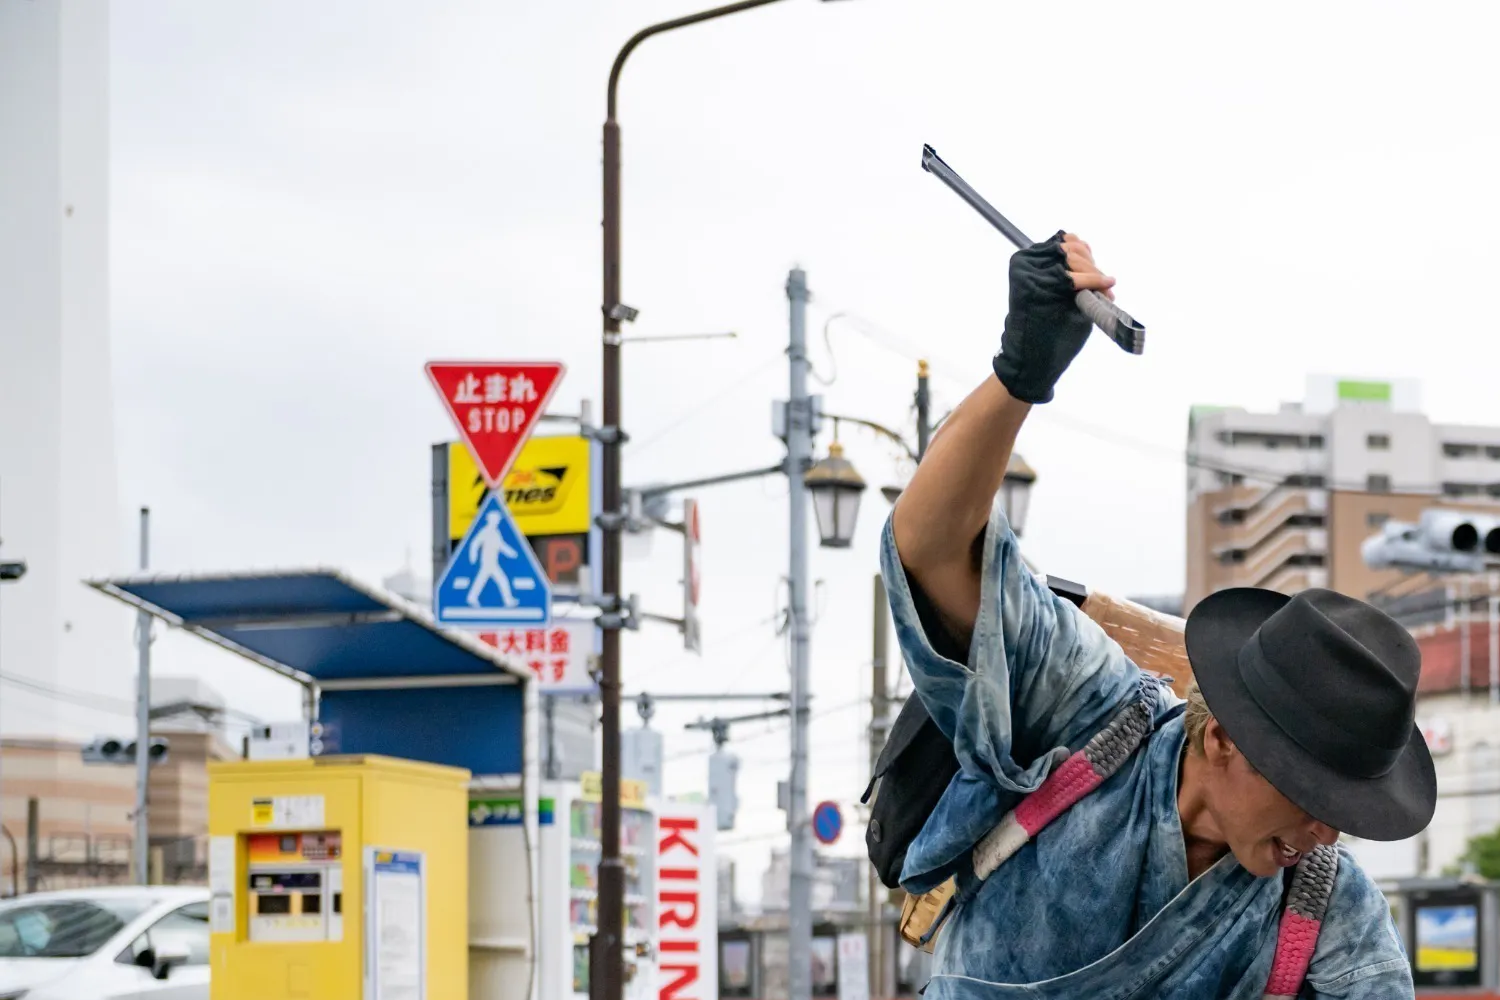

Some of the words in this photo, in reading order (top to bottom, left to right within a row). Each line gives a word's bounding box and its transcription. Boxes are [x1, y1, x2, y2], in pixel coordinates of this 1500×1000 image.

[453, 373, 538, 404] 止まれ
[467, 407, 526, 434] STOP
